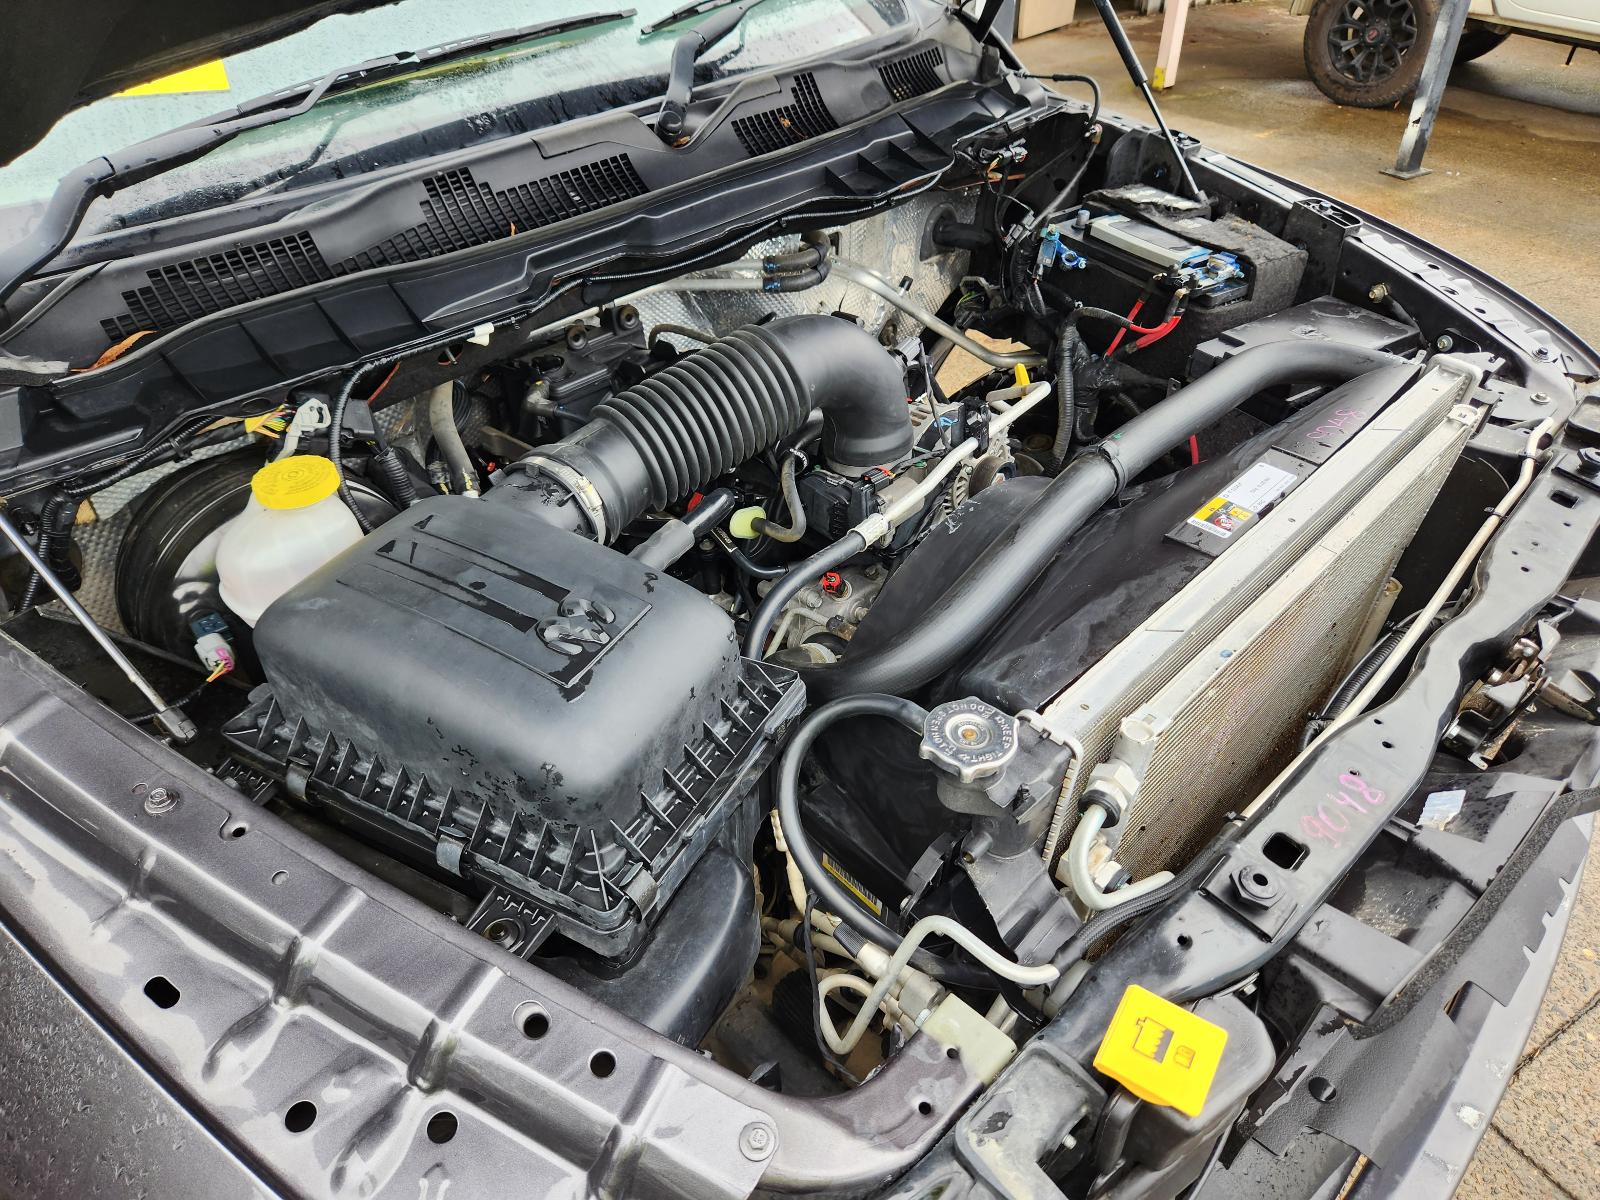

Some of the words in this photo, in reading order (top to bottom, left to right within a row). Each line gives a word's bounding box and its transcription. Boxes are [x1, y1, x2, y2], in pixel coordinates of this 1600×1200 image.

[1001, 723, 1012, 749] KEEP
[971, 751, 1003, 762] TIGHT
[1299, 774, 1386, 849] 9048
